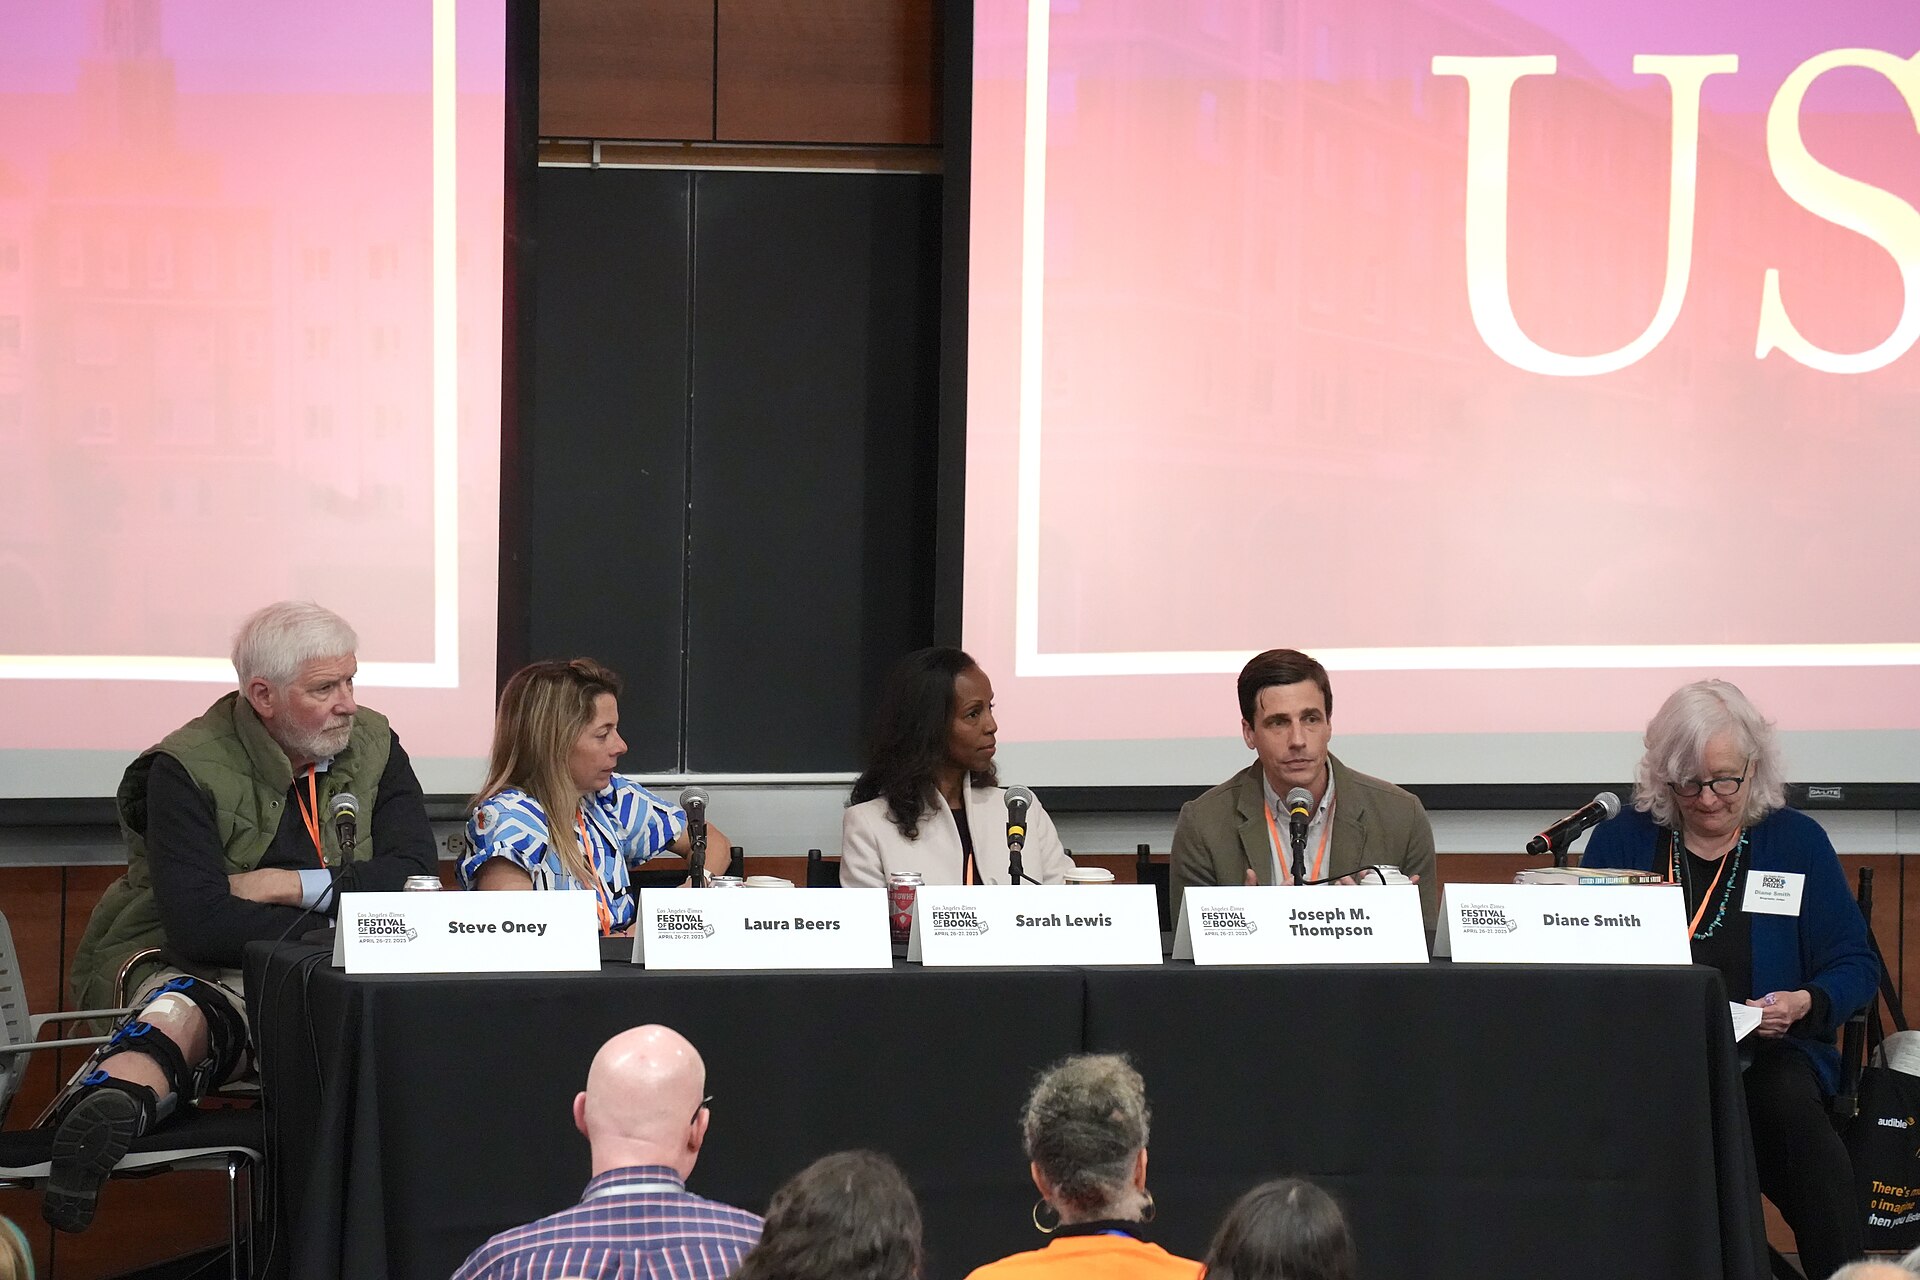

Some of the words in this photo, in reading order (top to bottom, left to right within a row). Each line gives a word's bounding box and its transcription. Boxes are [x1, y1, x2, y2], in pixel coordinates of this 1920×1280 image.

[1431, 48, 1920, 377] US
[657, 914, 703, 922] FESTIVAL
[932, 911, 977, 919] FESTIVAL
[1201, 912, 1246, 920] FESTIVAL
[1288, 907, 1345, 924] Joseph
[1349, 908, 1370, 921] M.
[1461, 909, 1506, 917] FESTIVAL
[358, 918, 406, 926] FESTIVAL
[744, 917, 790, 931] Laura
[794, 917, 841, 931] Beers
[943, 919, 978, 927] BOOKS
[1015, 913, 1061, 927] Sarah
[1065, 913, 1112, 927] Lewis
[1472, 917, 1506, 925] BOOKS
[1543, 912, 1590, 927] Diane
[1594, 912, 1641, 927] Smith
[448, 920, 497, 934] Steve
[501, 920, 548, 937] Oney
[668, 922, 704, 930] BOOKS
[1289, 924, 1373, 939] Thompson
[1877, 1118, 1908, 1129] audible
[1872, 1180, 1910, 1198] There's
